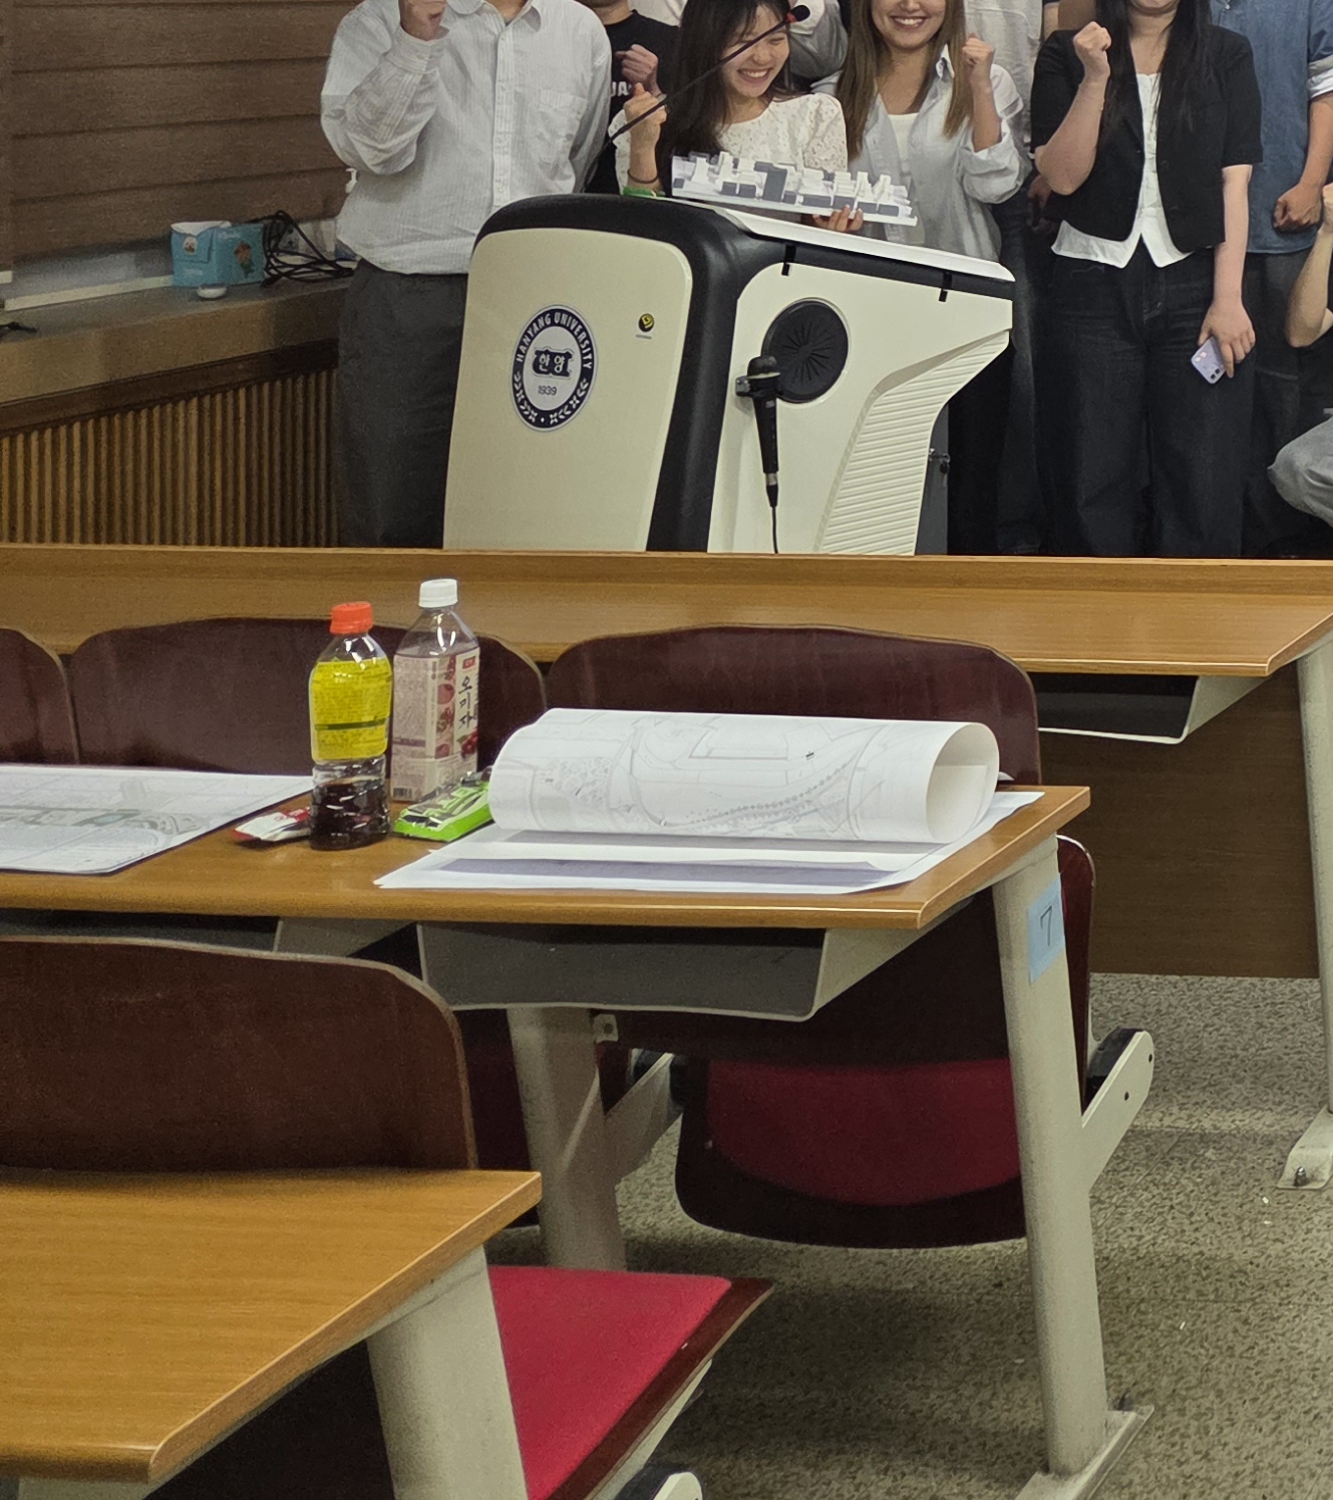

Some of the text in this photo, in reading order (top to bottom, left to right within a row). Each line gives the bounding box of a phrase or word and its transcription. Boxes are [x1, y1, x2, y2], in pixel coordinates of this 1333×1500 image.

[515, 311, 593, 369] HANYANG UNIVERSITY
[538, 353, 566, 374] 한양
[537, 385, 558, 396] 1939
[458, 675, 477, 730] 오미자
